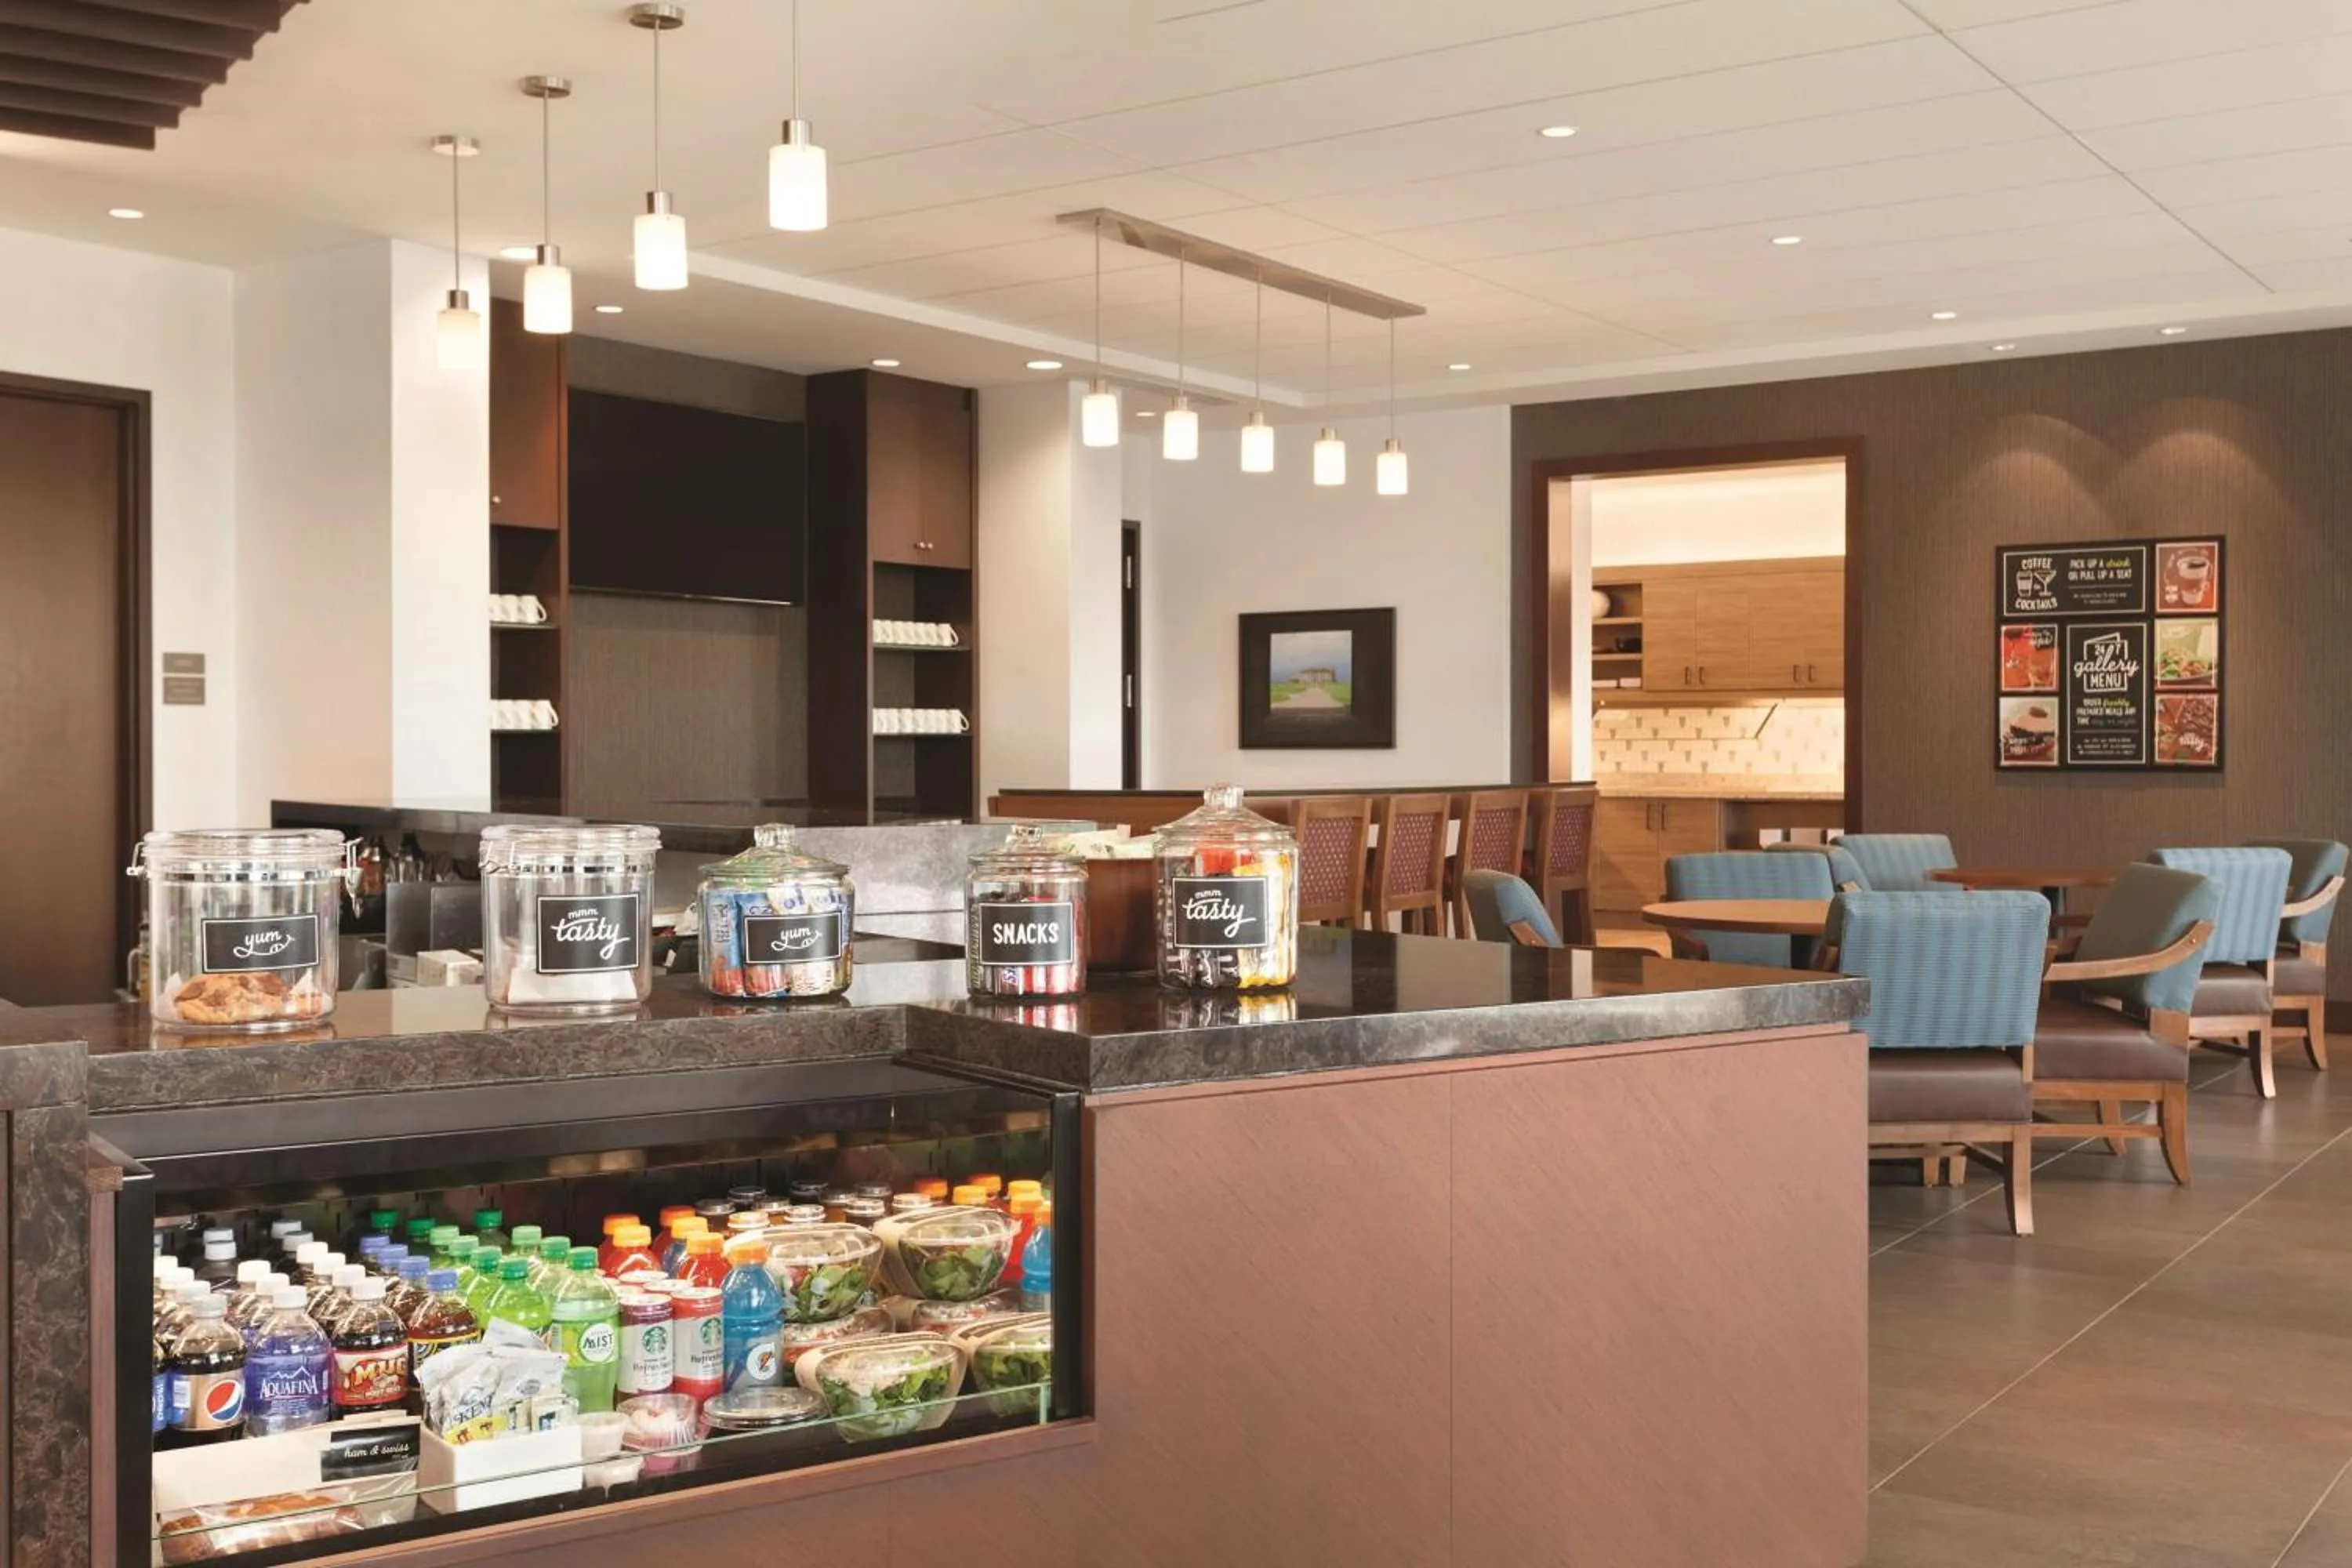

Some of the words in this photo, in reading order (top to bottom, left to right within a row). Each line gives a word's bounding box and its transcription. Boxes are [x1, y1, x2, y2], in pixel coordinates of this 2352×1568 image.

[2021, 557, 2053, 569] COFFEE
[2087, 558, 2097, 568] UP
[2099, 559, 2104, 568] A
[2080, 570, 2096, 580] PULL
[2098, 570, 2107, 579] UP
[2109, 570, 2114, 579] A
[2117, 568, 2132, 579] SEAT
[2015, 597, 2058, 611] COCKTAILS
[2074, 644, 2140, 678] gallery
[2090, 673, 2122, 688] MENU
[568, 907, 599, 920] mmm
[1181, 898, 1258, 938] tasty
[550, 916, 630, 960] tasty
[771, 927, 822, 952] yum
[992, 921, 1059, 945] SNACKS
[233, 930, 296, 959] yum
[583, 1334, 613, 1349] MIST
[260, 1374, 318, 1400] AQUAFINA
